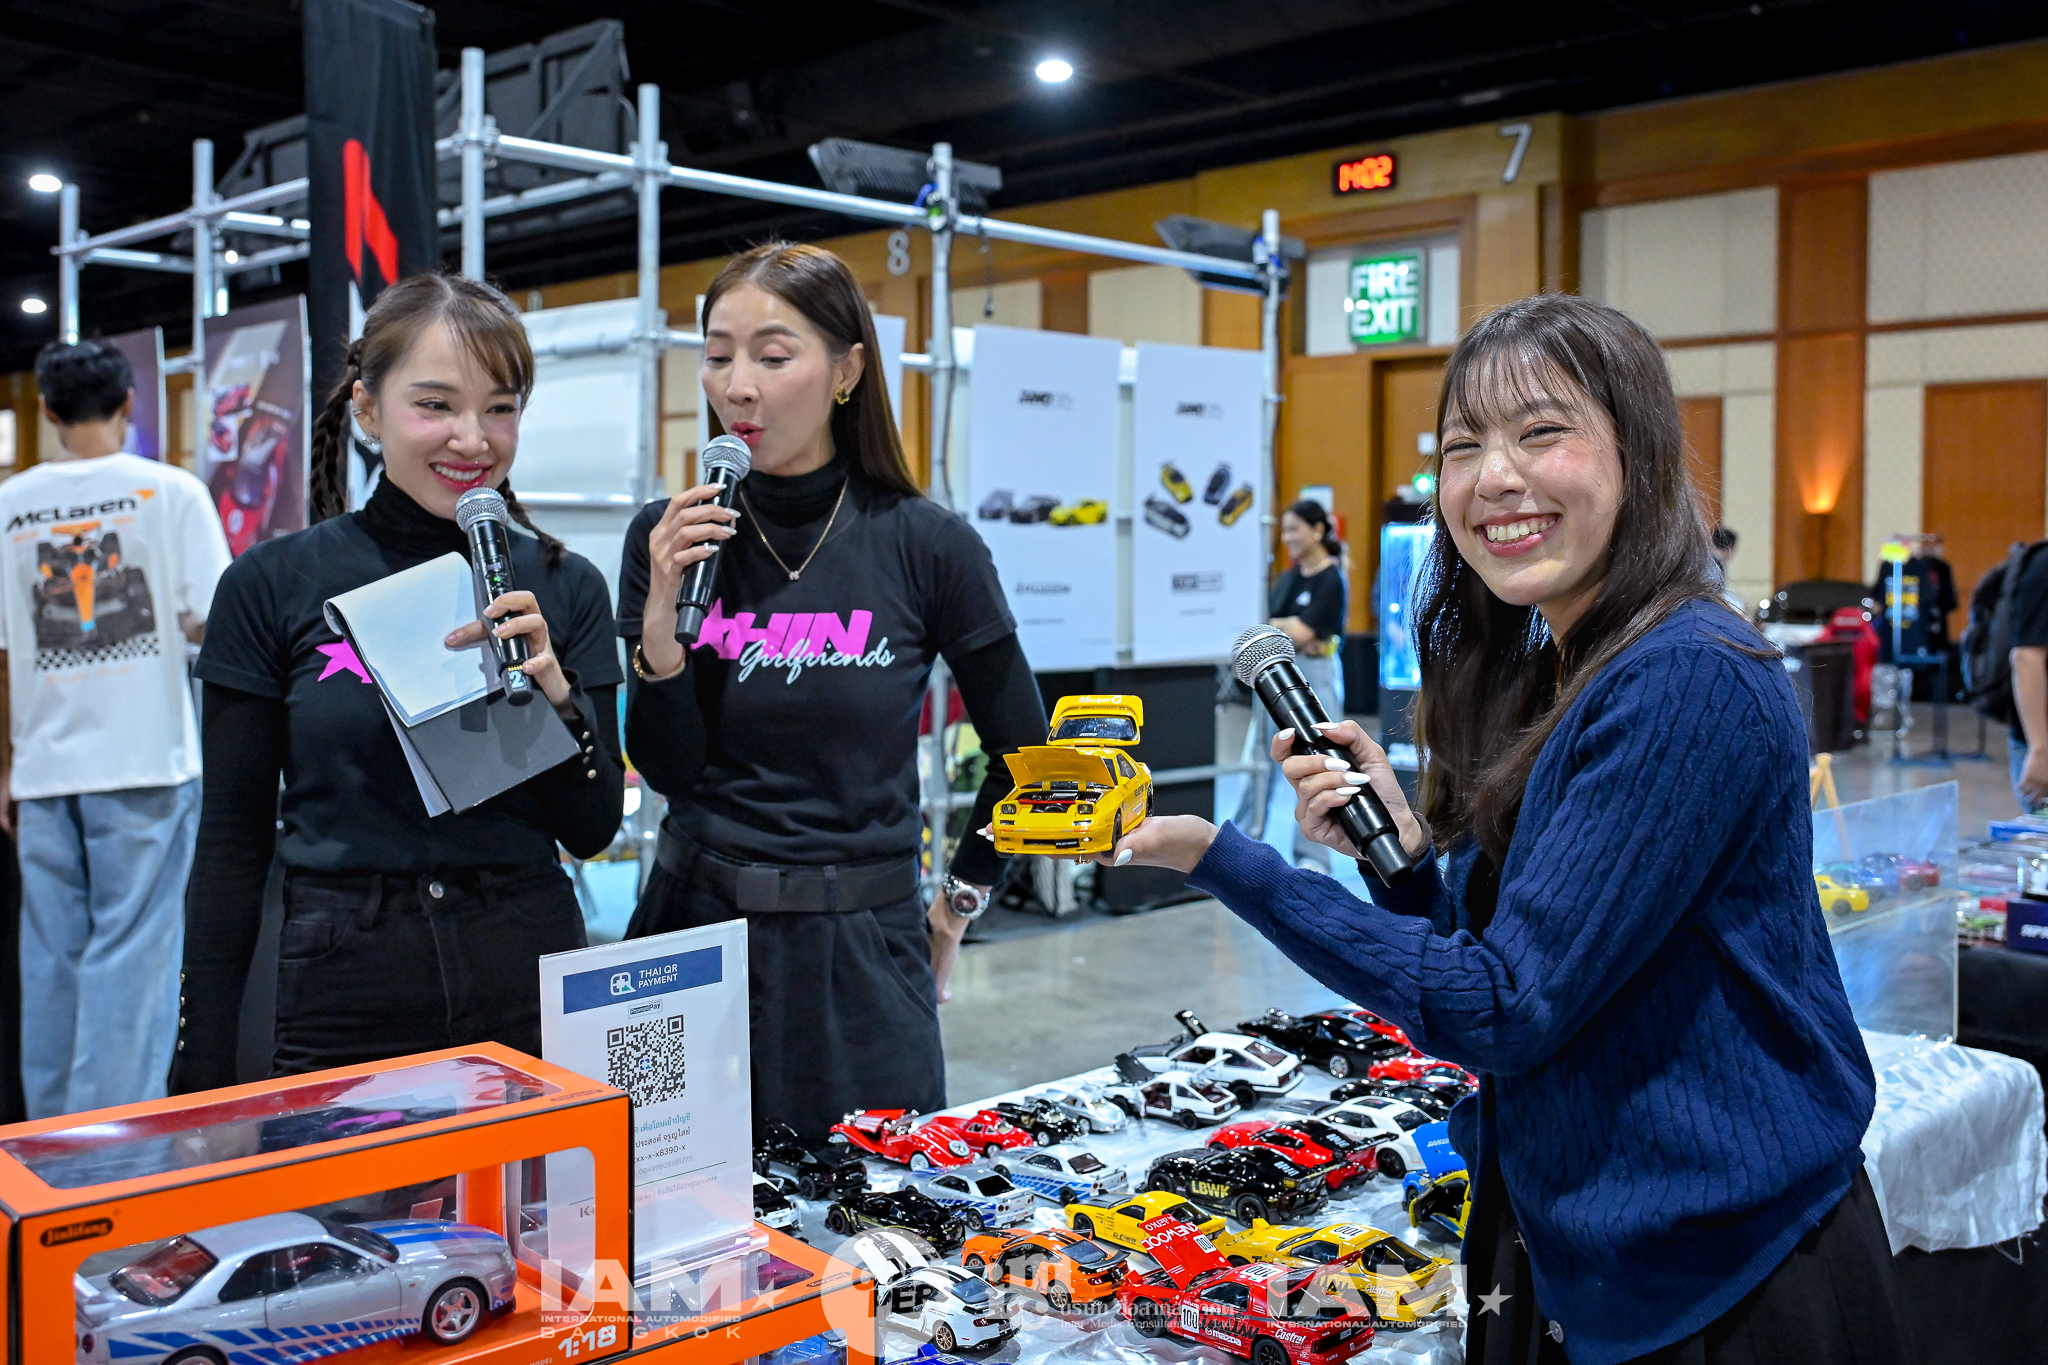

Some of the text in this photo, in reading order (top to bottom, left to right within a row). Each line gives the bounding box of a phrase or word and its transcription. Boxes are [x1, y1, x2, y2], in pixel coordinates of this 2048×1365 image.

[1499, 123, 1532, 183] 7
[887, 230, 910, 276] 8
[1352, 260, 1418, 299] FIRE
[1352, 300, 1417, 336] EXIT
[7, 498, 136, 532] McLaren
[737, 636, 896, 685] Girlfriends
[638, 963, 678, 979] THAI QR
[638, 973, 679, 989] PAYMENT
[1191, 1180, 1231, 1199] LBWK
[1183, 1308, 1199, 1330] 100
[558, 1325, 617, 1358] 1:18
[1212, 1329, 1242, 1347] mazda
